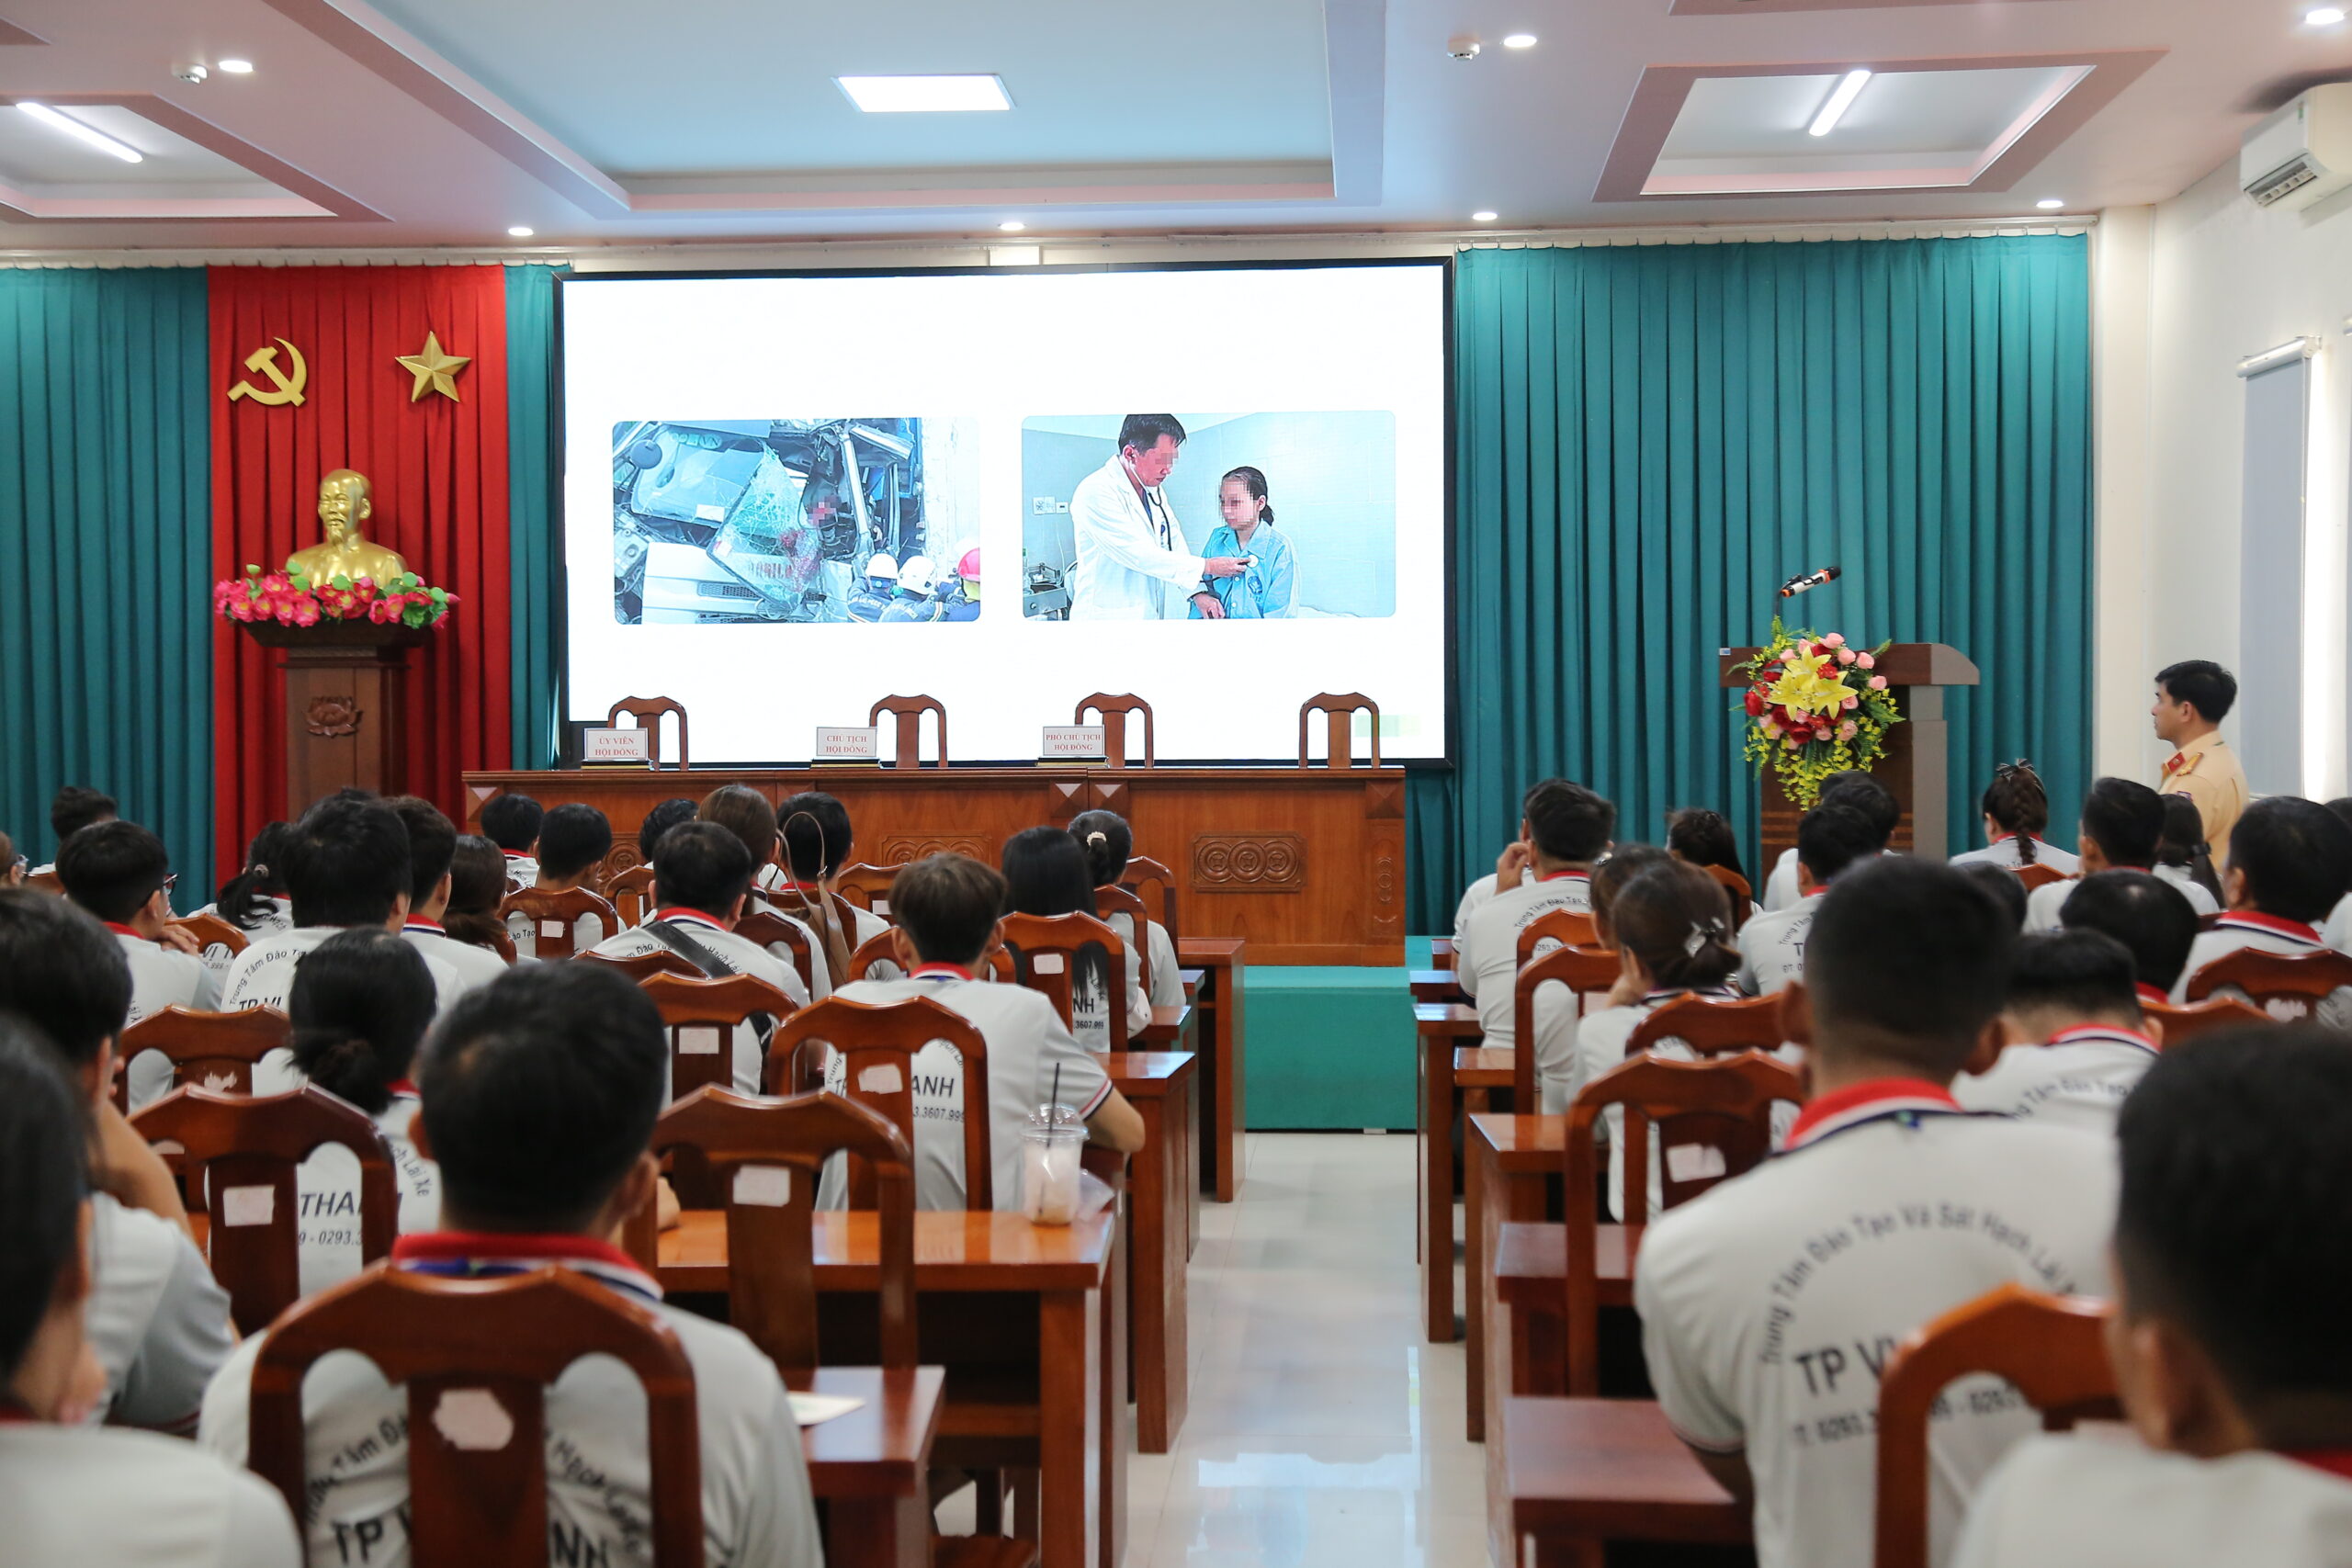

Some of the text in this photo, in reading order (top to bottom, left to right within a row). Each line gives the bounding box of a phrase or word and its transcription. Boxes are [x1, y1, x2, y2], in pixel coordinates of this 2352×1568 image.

[613, 736, 634, 745] VIÊN
[826, 733, 867, 744] CHỦ TỊCH
[1063, 732, 1080, 741] CHỦ
[1082, 734, 1101, 742] TỊCH
[826, 745, 842, 754] HỘI
[1054, 742, 1069, 751] HỘI
[595, 748, 611, 757] HỘI
[229, 977, 248, 1006] Trung
[244, 959, 265, 978] Tâm
[266, 950, 288, 963] Đào
[300, 1191, 362, 1218] THA
[1795, 1347, 1847, 1396] TP
[331, 1517, 383, 1565] TP
